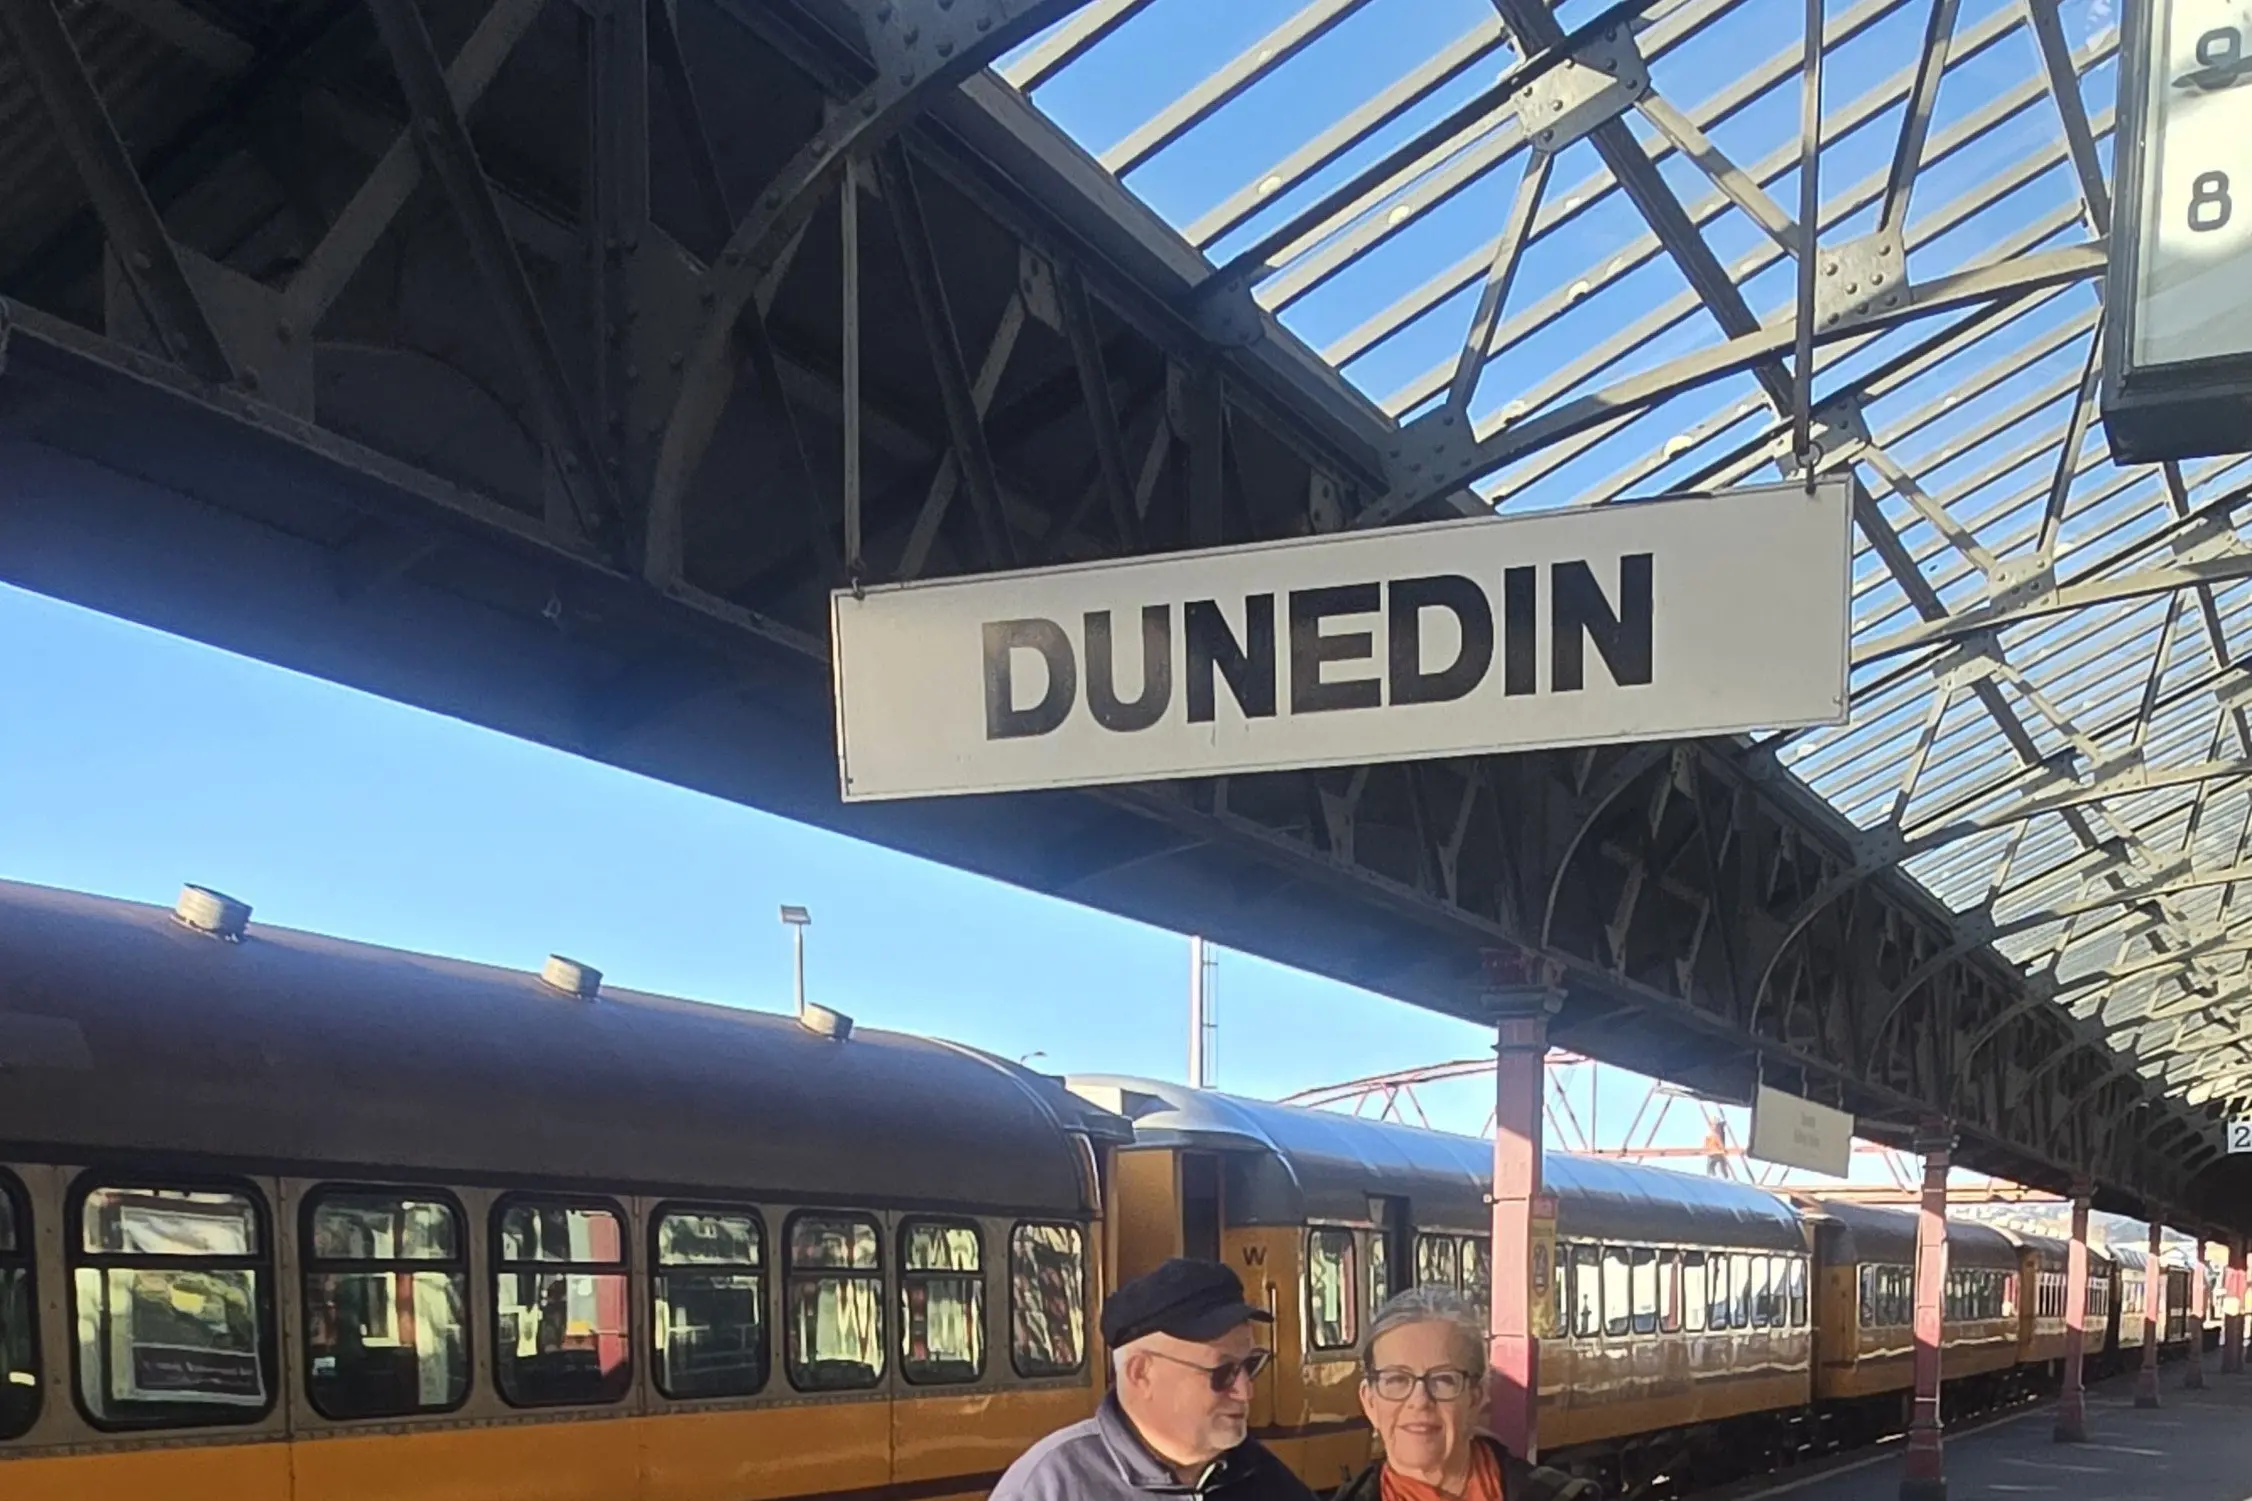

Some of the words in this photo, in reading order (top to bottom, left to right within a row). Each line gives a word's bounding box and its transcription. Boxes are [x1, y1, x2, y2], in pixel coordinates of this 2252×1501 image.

[2196, 26, 2241, 90] 9
[2187, 169, 2232, 232] 8
[982, 552, 1655, 741] DUNEDIN
[2234, 1125, 2251, 1148] 2
[1242, 1246, 1268, 1266] W
